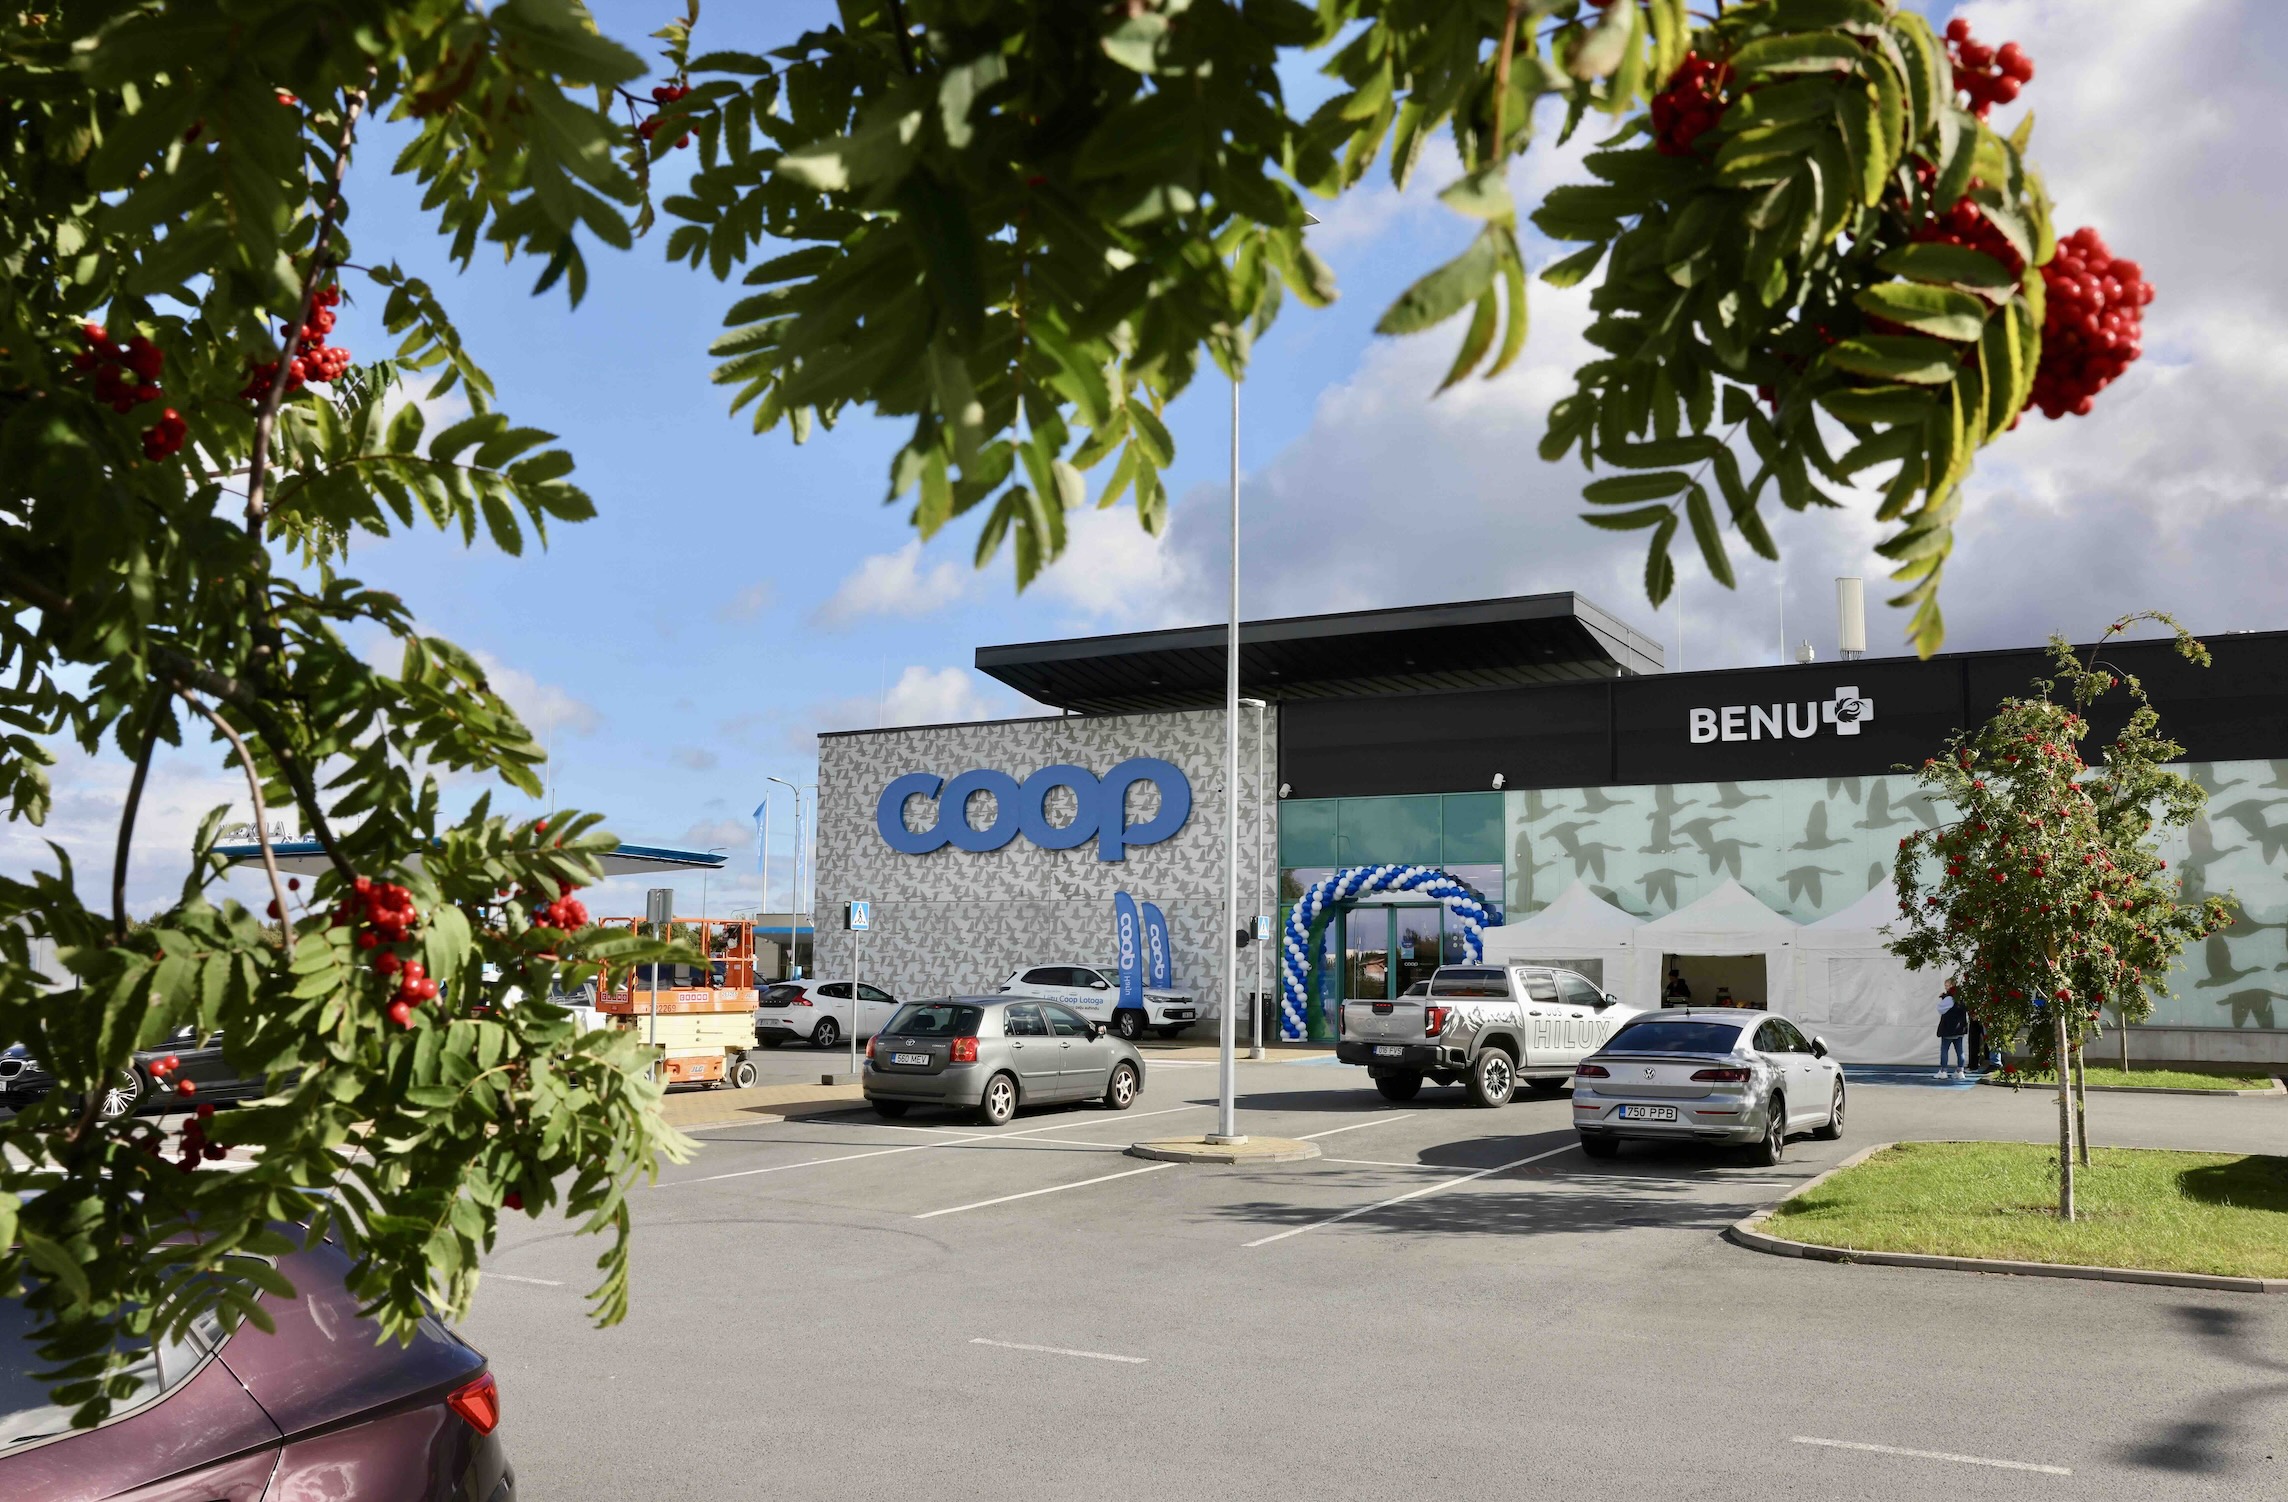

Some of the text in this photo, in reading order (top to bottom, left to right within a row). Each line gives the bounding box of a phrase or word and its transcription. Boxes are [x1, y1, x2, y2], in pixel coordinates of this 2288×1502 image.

[1690, 701, 1818, 743] BENU
[877, 757, 1192, 861] coop
[1060, 995, 1078, 1004] Coop
[1079, 996, 1104, 1006] Lotoga
[1545, 1007, 1562, 1017] UUS
[1533, 1020, 1610, 1049] HILUX
[910, 1055, 927, 1064] MEV
[1627, 1107, 1674, 1119] 750 PPB
